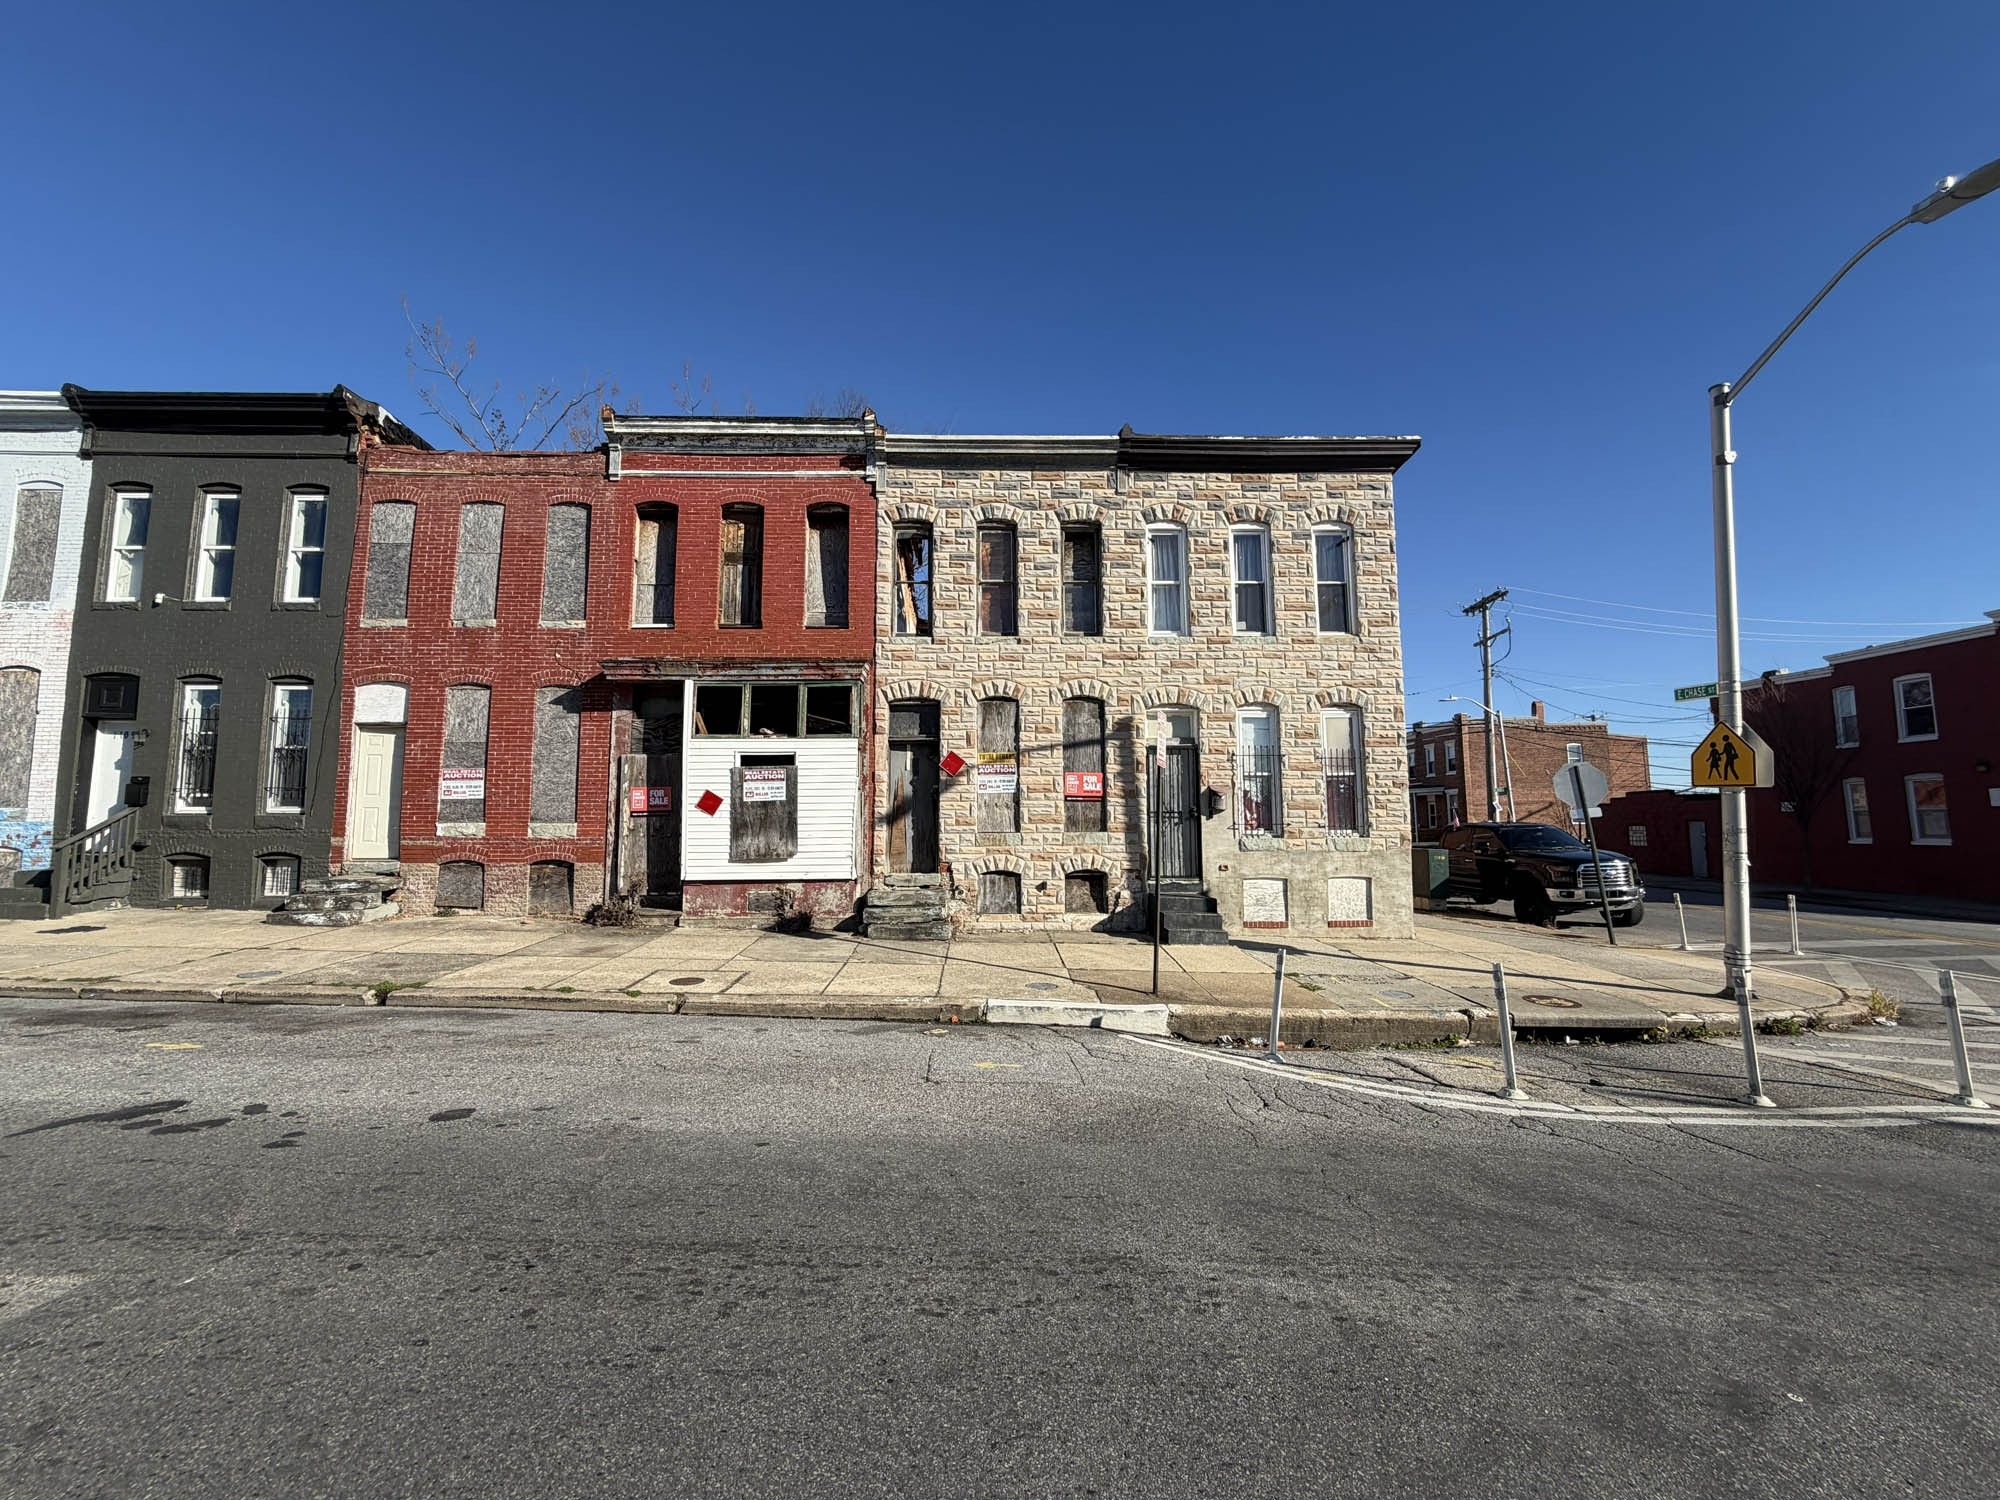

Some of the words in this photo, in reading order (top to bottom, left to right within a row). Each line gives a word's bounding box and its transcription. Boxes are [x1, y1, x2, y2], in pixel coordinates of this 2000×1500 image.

[1677, 688, 1683, 699] E
[1684, 686, 1706, 698] CHASE
[1083, 782, 1103, 790] SALE
[649, 797, 669, 805] SALE
